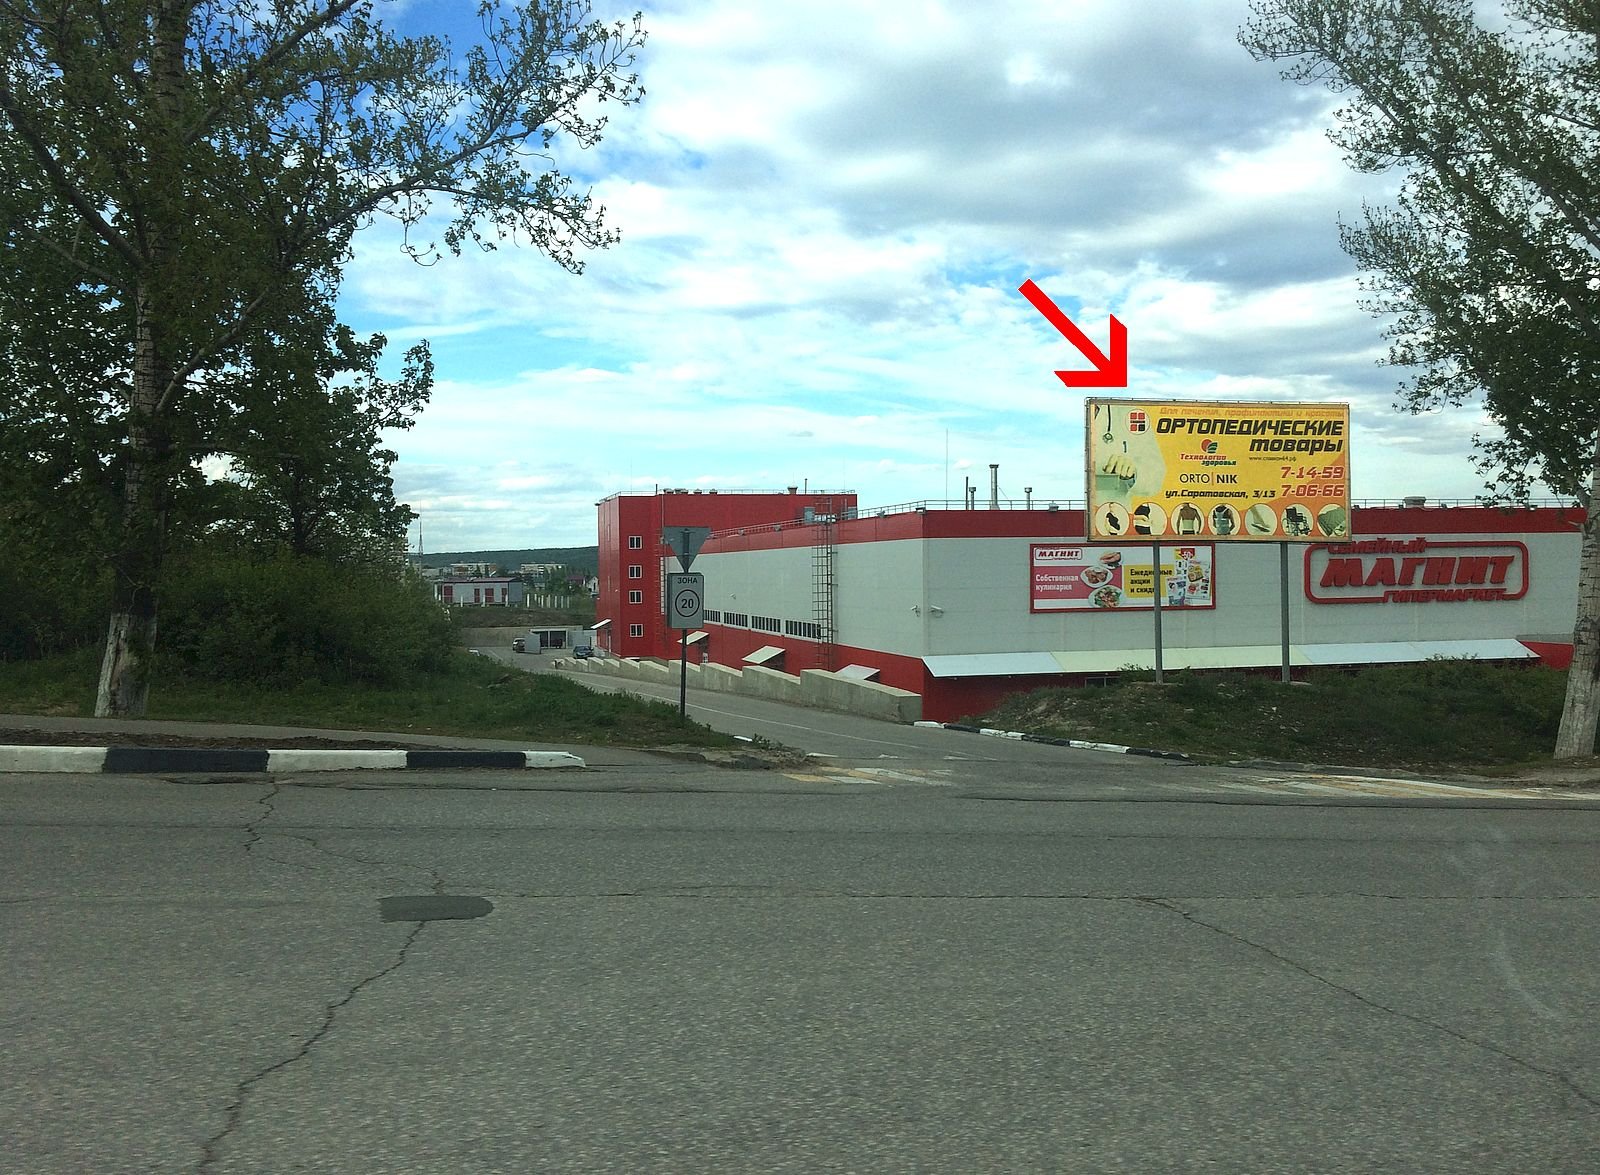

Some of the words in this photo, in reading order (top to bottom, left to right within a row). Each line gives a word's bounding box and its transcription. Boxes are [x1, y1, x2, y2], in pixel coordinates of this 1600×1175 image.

[1156, 418, 1345, 436] ОРТОПЕДИЧЕСКИЕ
[1249, 438, 1343, 455] товары
[1180, 453, 1227, 461] Технологии
[1281, 466, 1345, 479] 7-14-59
[1179, 474, 1210, 484] ORTO
[1216, 474, 1238, 484] NIK
[1165, 490, 1249, 499] ул.Саратовская,
[1253, 490, 1276, 499] 3/13
[1281, 485, 1345, 497] 7-06-66
[1320, 556, 1515, 587] МАГНИТ
[1035, 574, 1079, 582] Собственная
[1035, 584, 1073, 593] кулинария
[1384, 588, 1507, 602] ГИПЕРМАРКЕТ
[681, 598, 694, 609] 20
